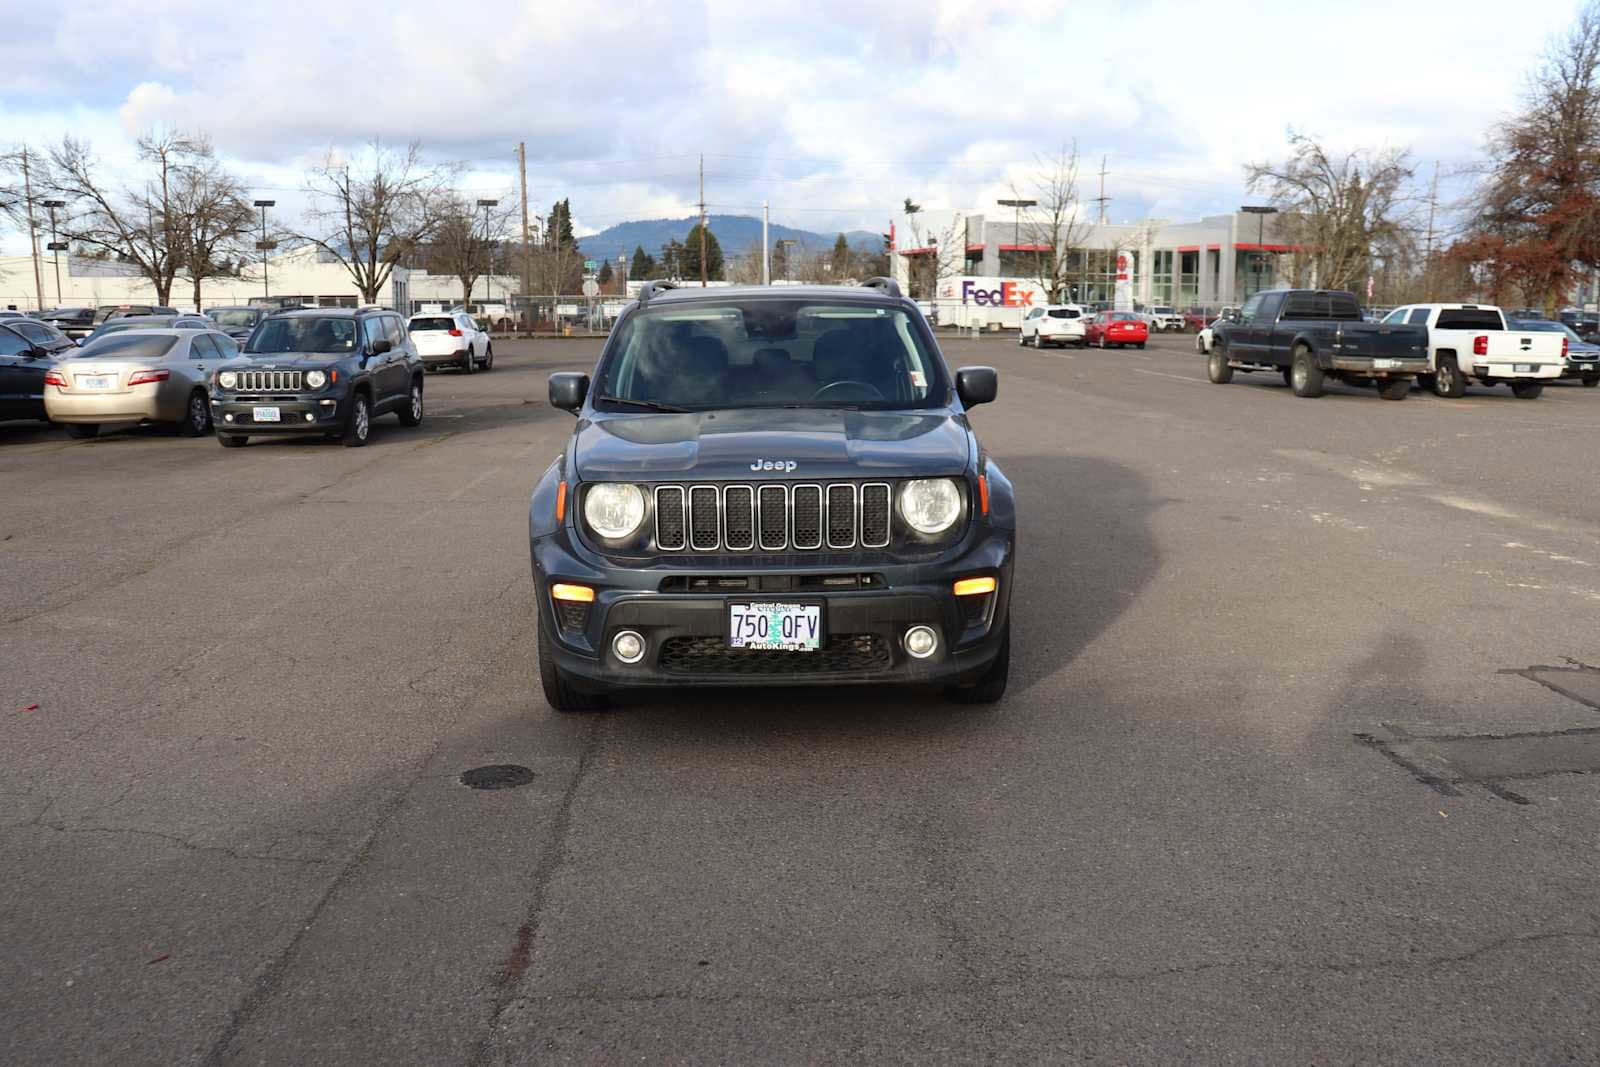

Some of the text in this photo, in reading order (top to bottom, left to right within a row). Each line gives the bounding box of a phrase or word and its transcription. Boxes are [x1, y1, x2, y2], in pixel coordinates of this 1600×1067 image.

[962, 281, 1034, 306] FedEx
[750, 459, 797, 473] Jeep
[733, 615, 817, 639] 750 QFV
[750, 642, 799, 651] AutoKings
